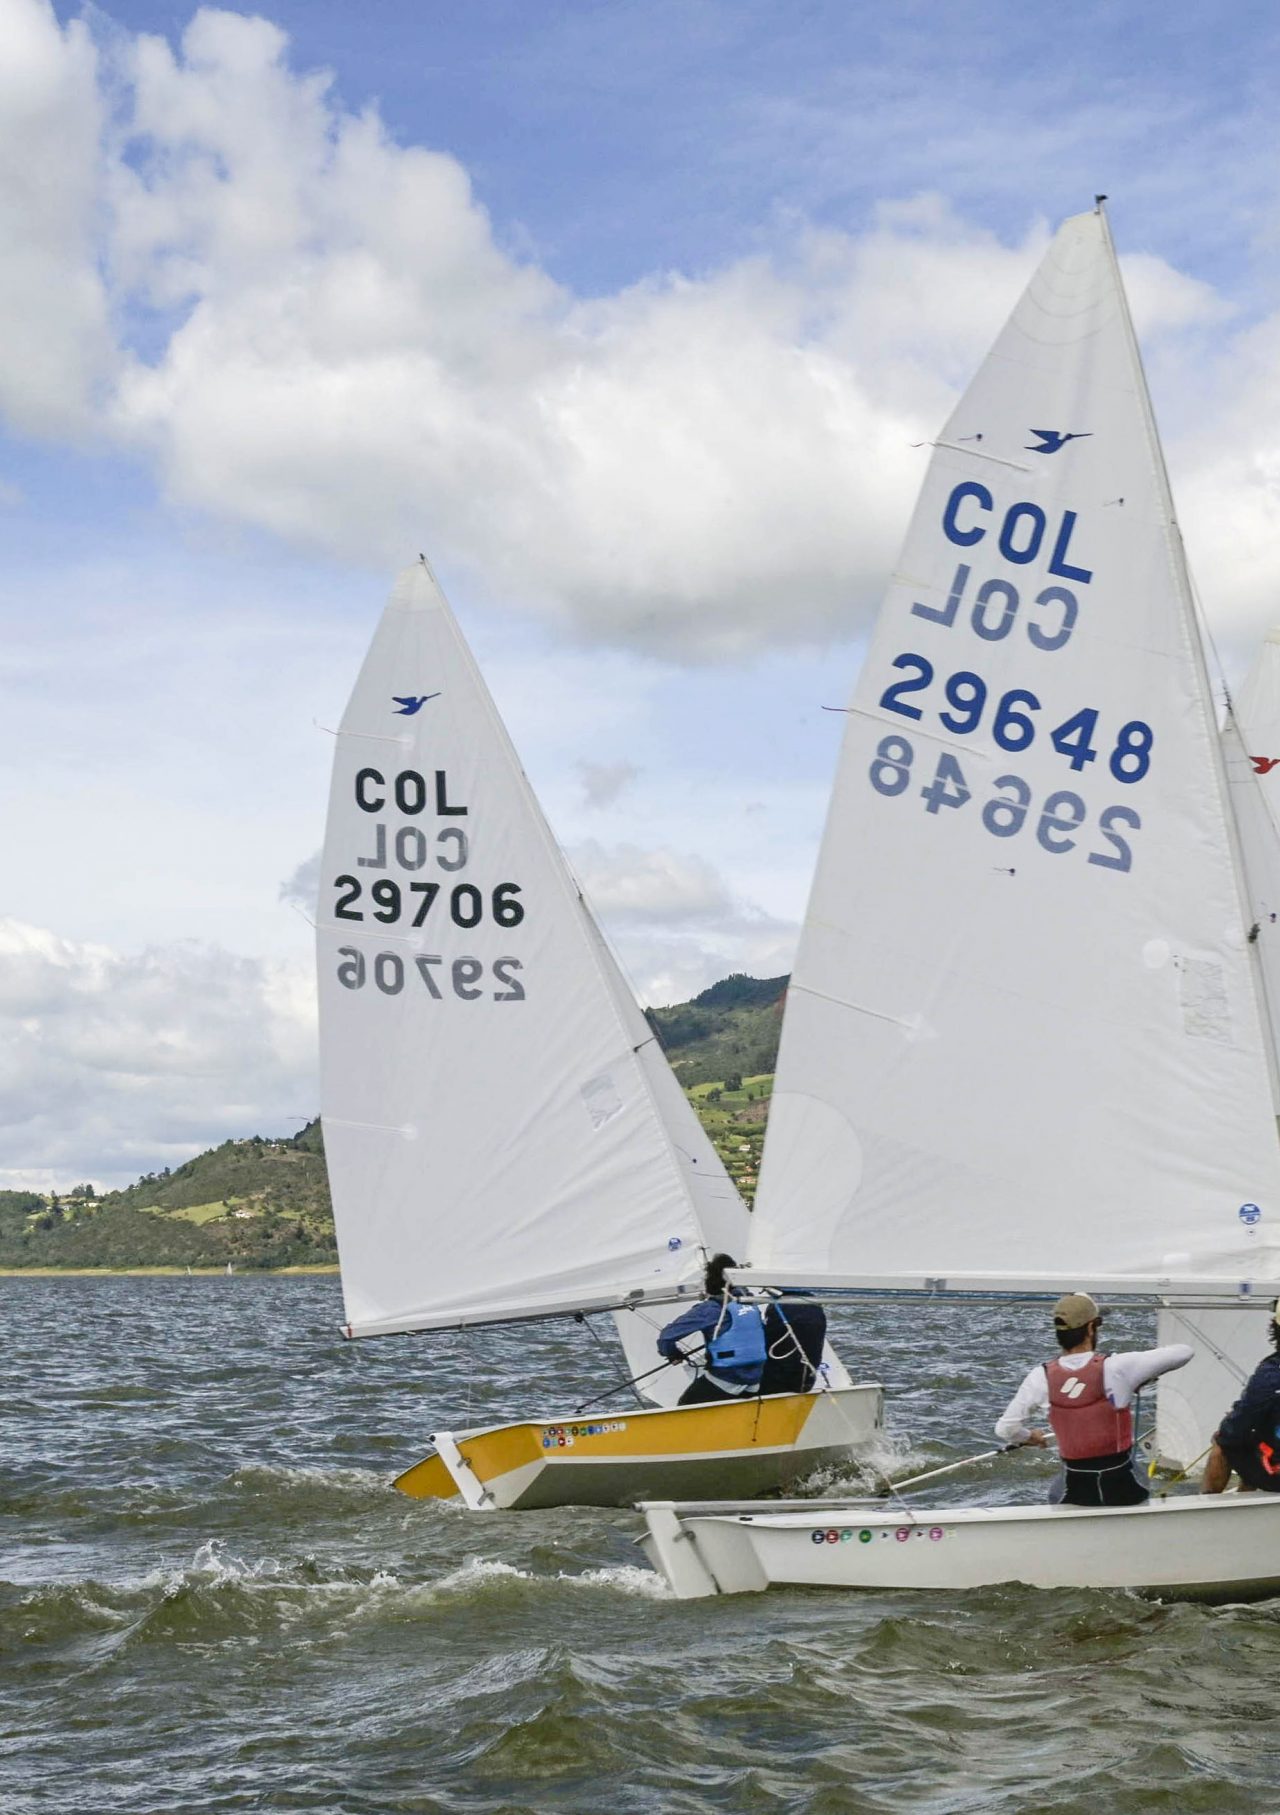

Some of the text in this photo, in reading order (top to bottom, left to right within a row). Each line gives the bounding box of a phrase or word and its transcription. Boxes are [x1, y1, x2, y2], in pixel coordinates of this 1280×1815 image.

[943, 481, 1093, 584] COL
[879, 652, 1154, 785] 29648
[355, 767, 468, 816] COL
[333, 874, 525, 929] 29706
